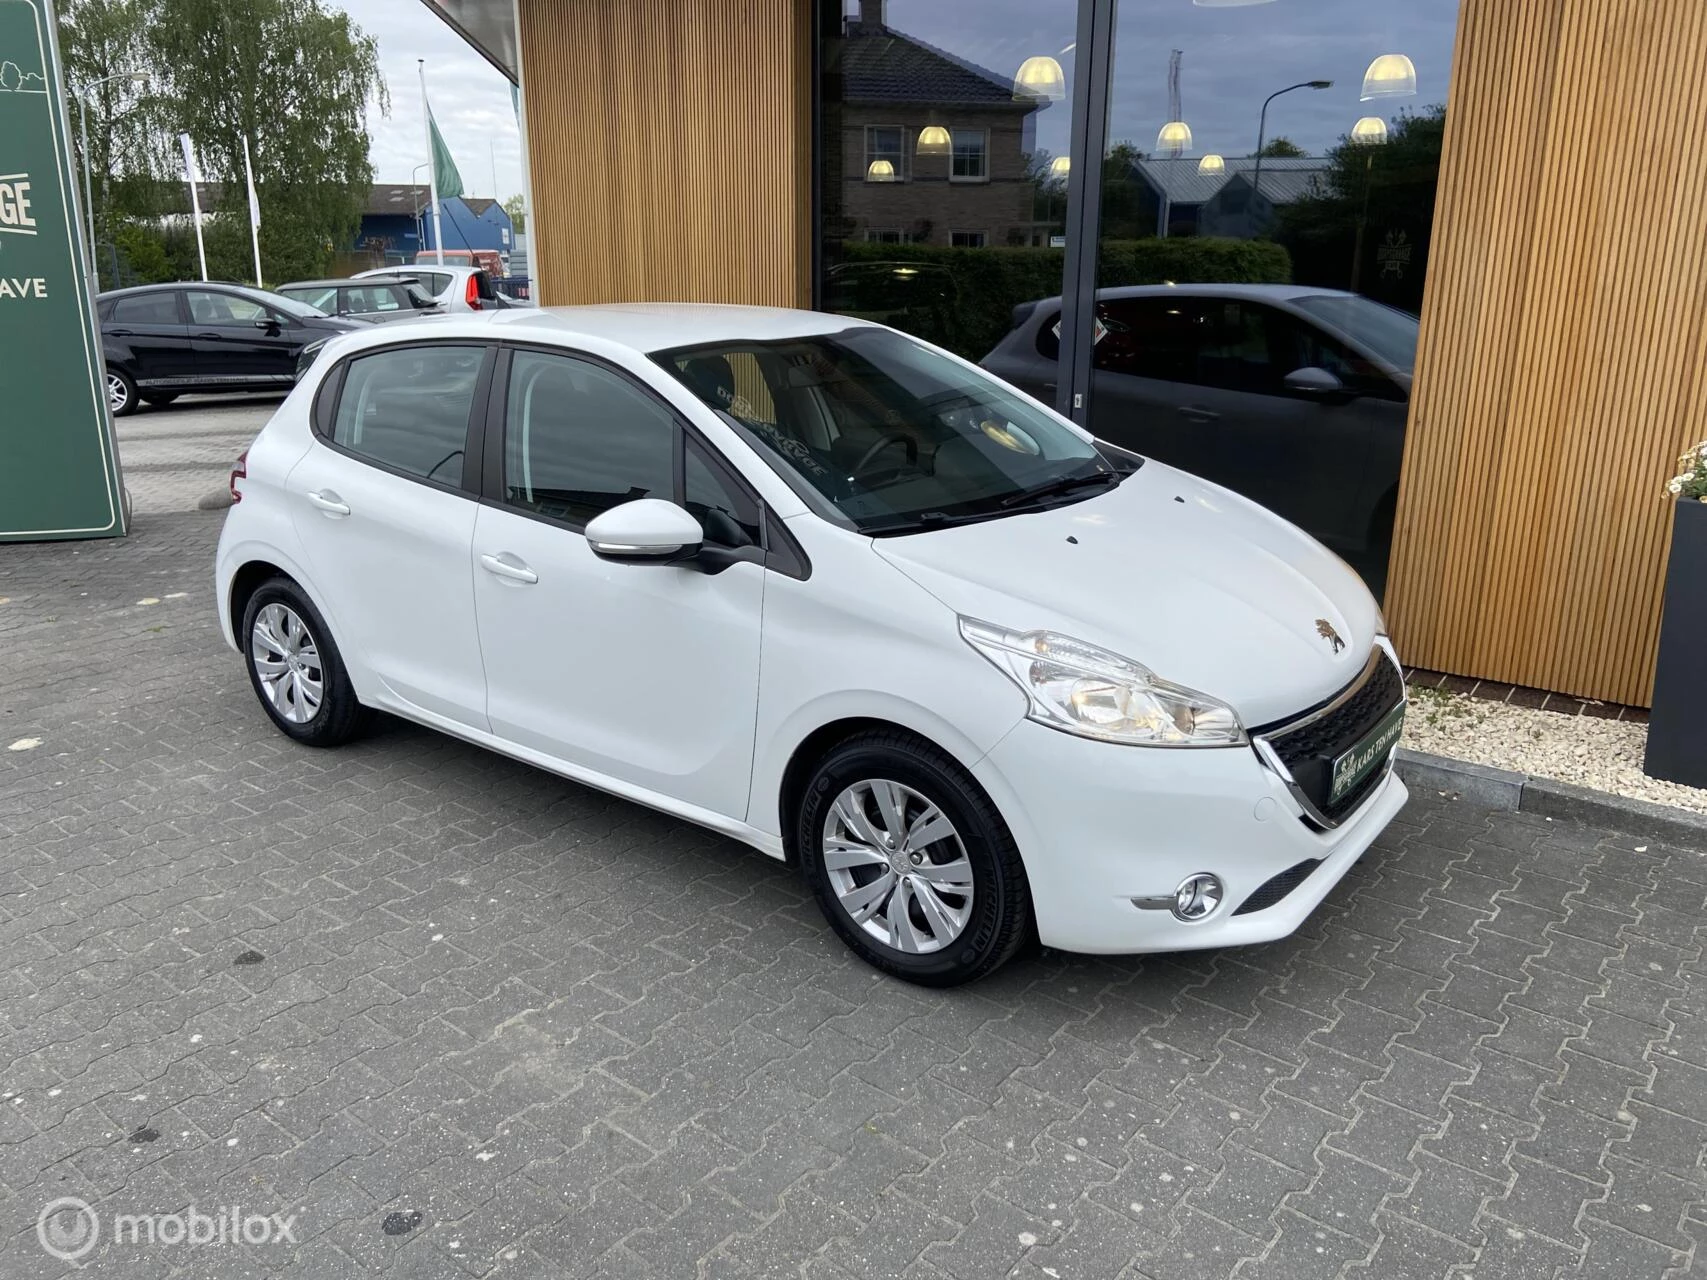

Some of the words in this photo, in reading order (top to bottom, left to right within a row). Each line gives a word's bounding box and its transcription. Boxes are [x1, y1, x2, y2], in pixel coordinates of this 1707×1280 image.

[1357, 744, 1375, 772] KARS
[1376, 735, 1386, 754] TEN
[973, 867, 997, 950] MICHELIN
